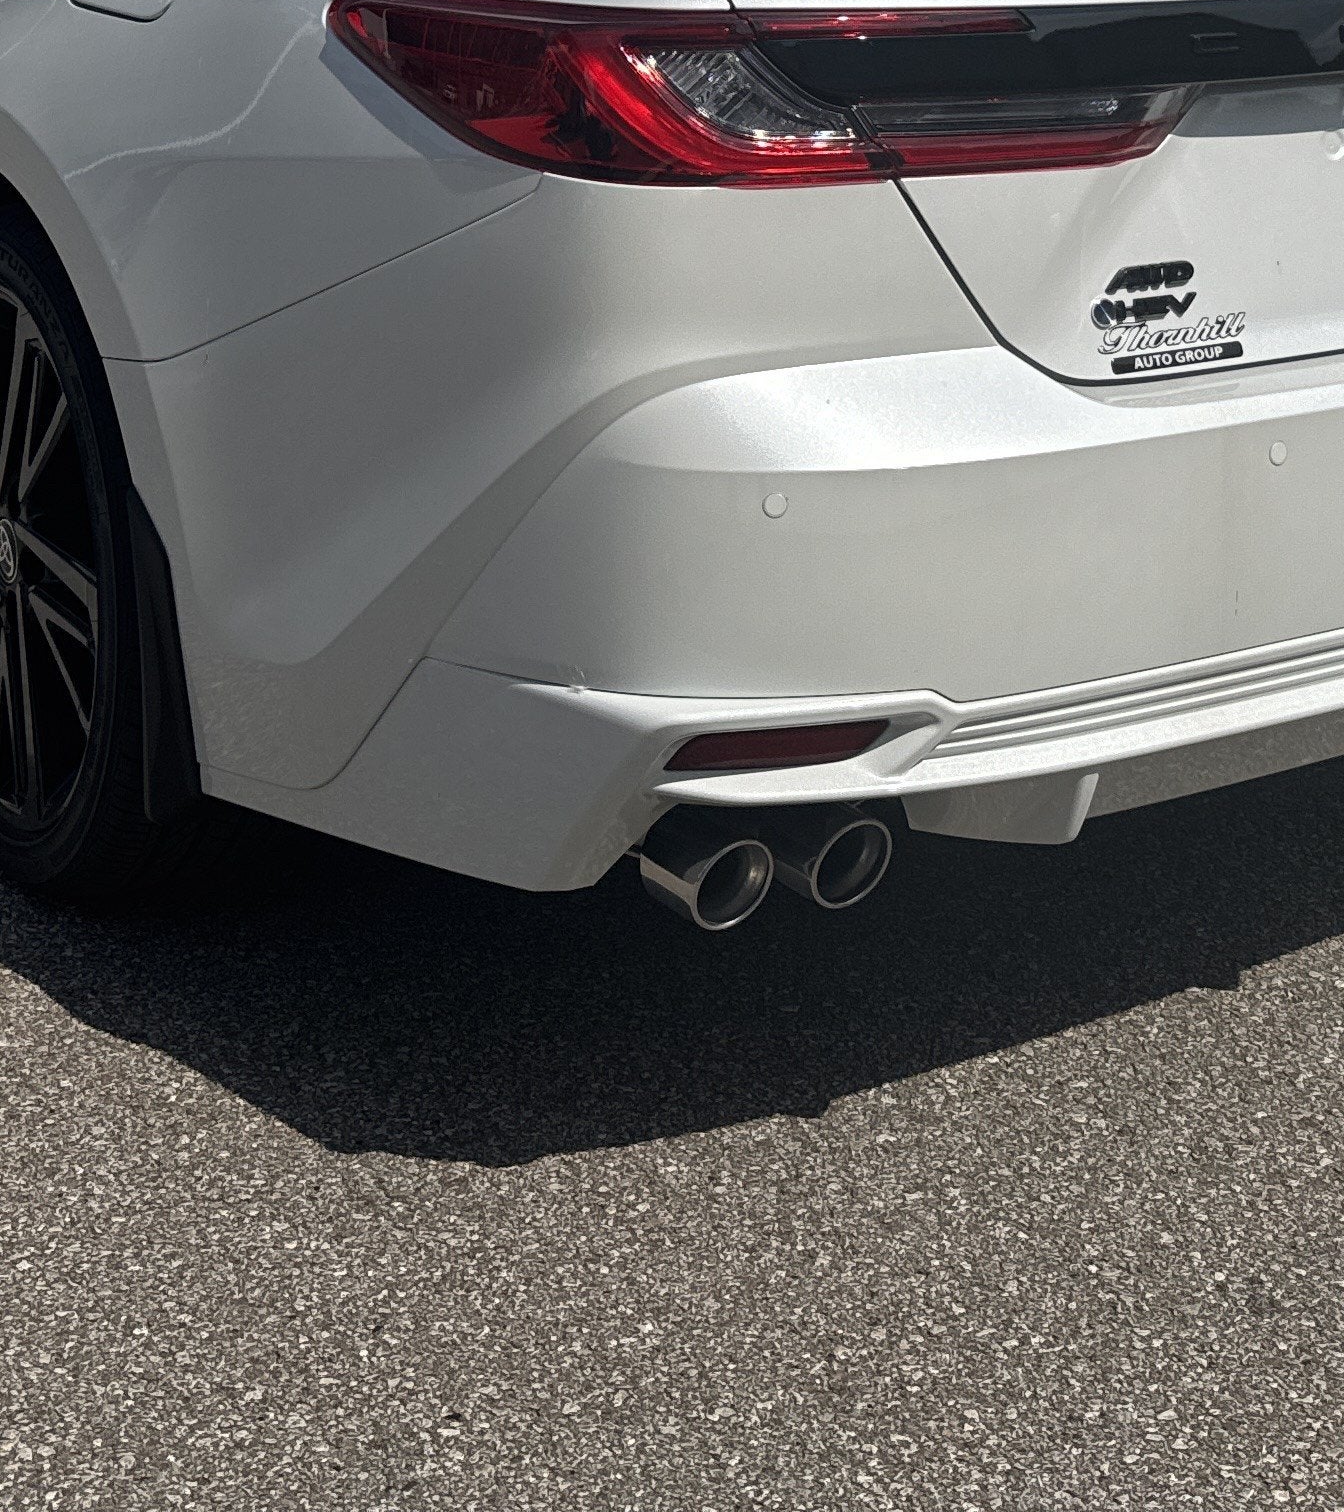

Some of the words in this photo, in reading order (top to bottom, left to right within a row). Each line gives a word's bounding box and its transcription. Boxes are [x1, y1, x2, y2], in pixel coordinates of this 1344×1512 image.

[1097, 311, 1246, 355] Thornhill
[1133, 350, 1173, 371] AUTO
[1174, 345, 1224, 366] GROUP
